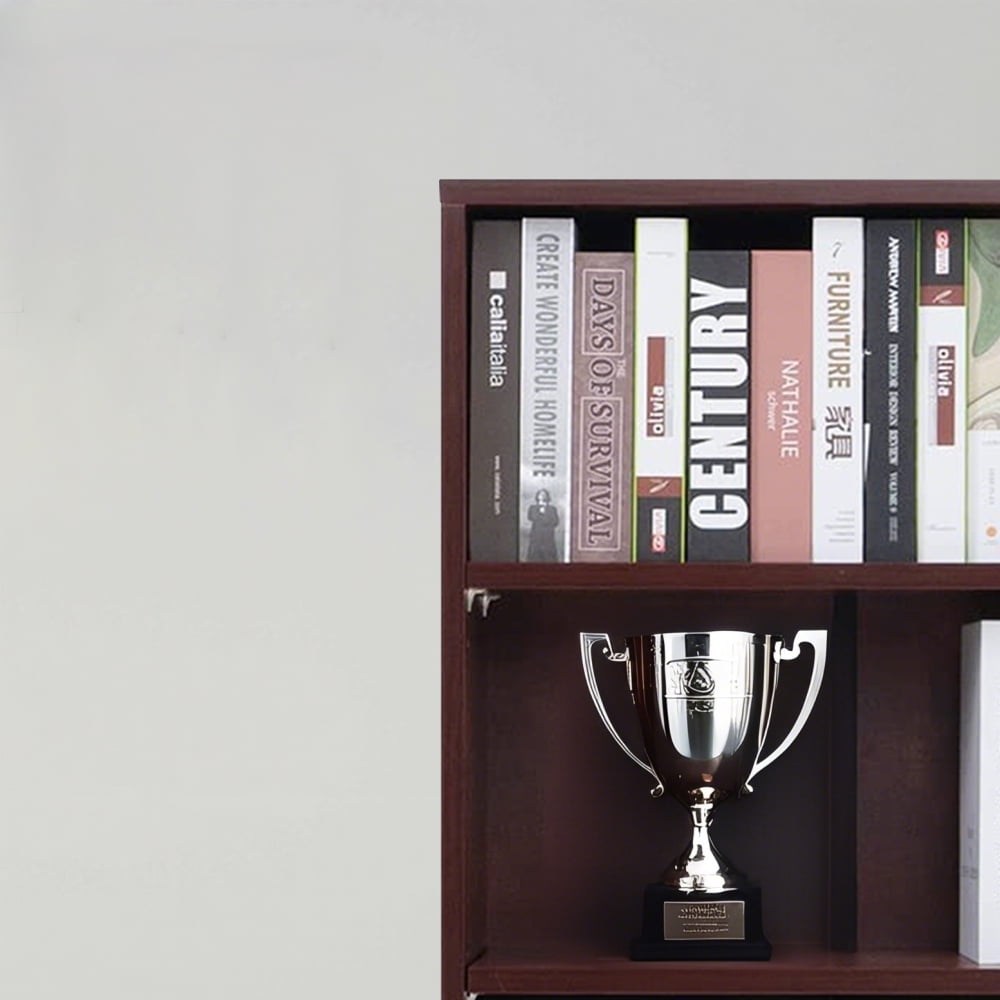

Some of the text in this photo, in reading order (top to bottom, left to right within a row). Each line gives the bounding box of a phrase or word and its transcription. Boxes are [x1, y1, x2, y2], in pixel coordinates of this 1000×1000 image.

[530, 233, 560, 477] CREATE WONDERFUL HOMELIFE
[827, 272, 850, 388] FURNITURE
[888, 237, 899, 505] ANDREW MARTIN INTERIOR DESIGN REVIEW VOLUME
[938, 349, 949, 397] olivia
[588, 279, 614, 546] DAYS OF SURVIVAL
[649, 386, 665, 435] olivia
[689, 278, 748, 529] CENTURY
[781, 361, 799, 457] NATHALIE
[825, 407, 853, 459] 家具
